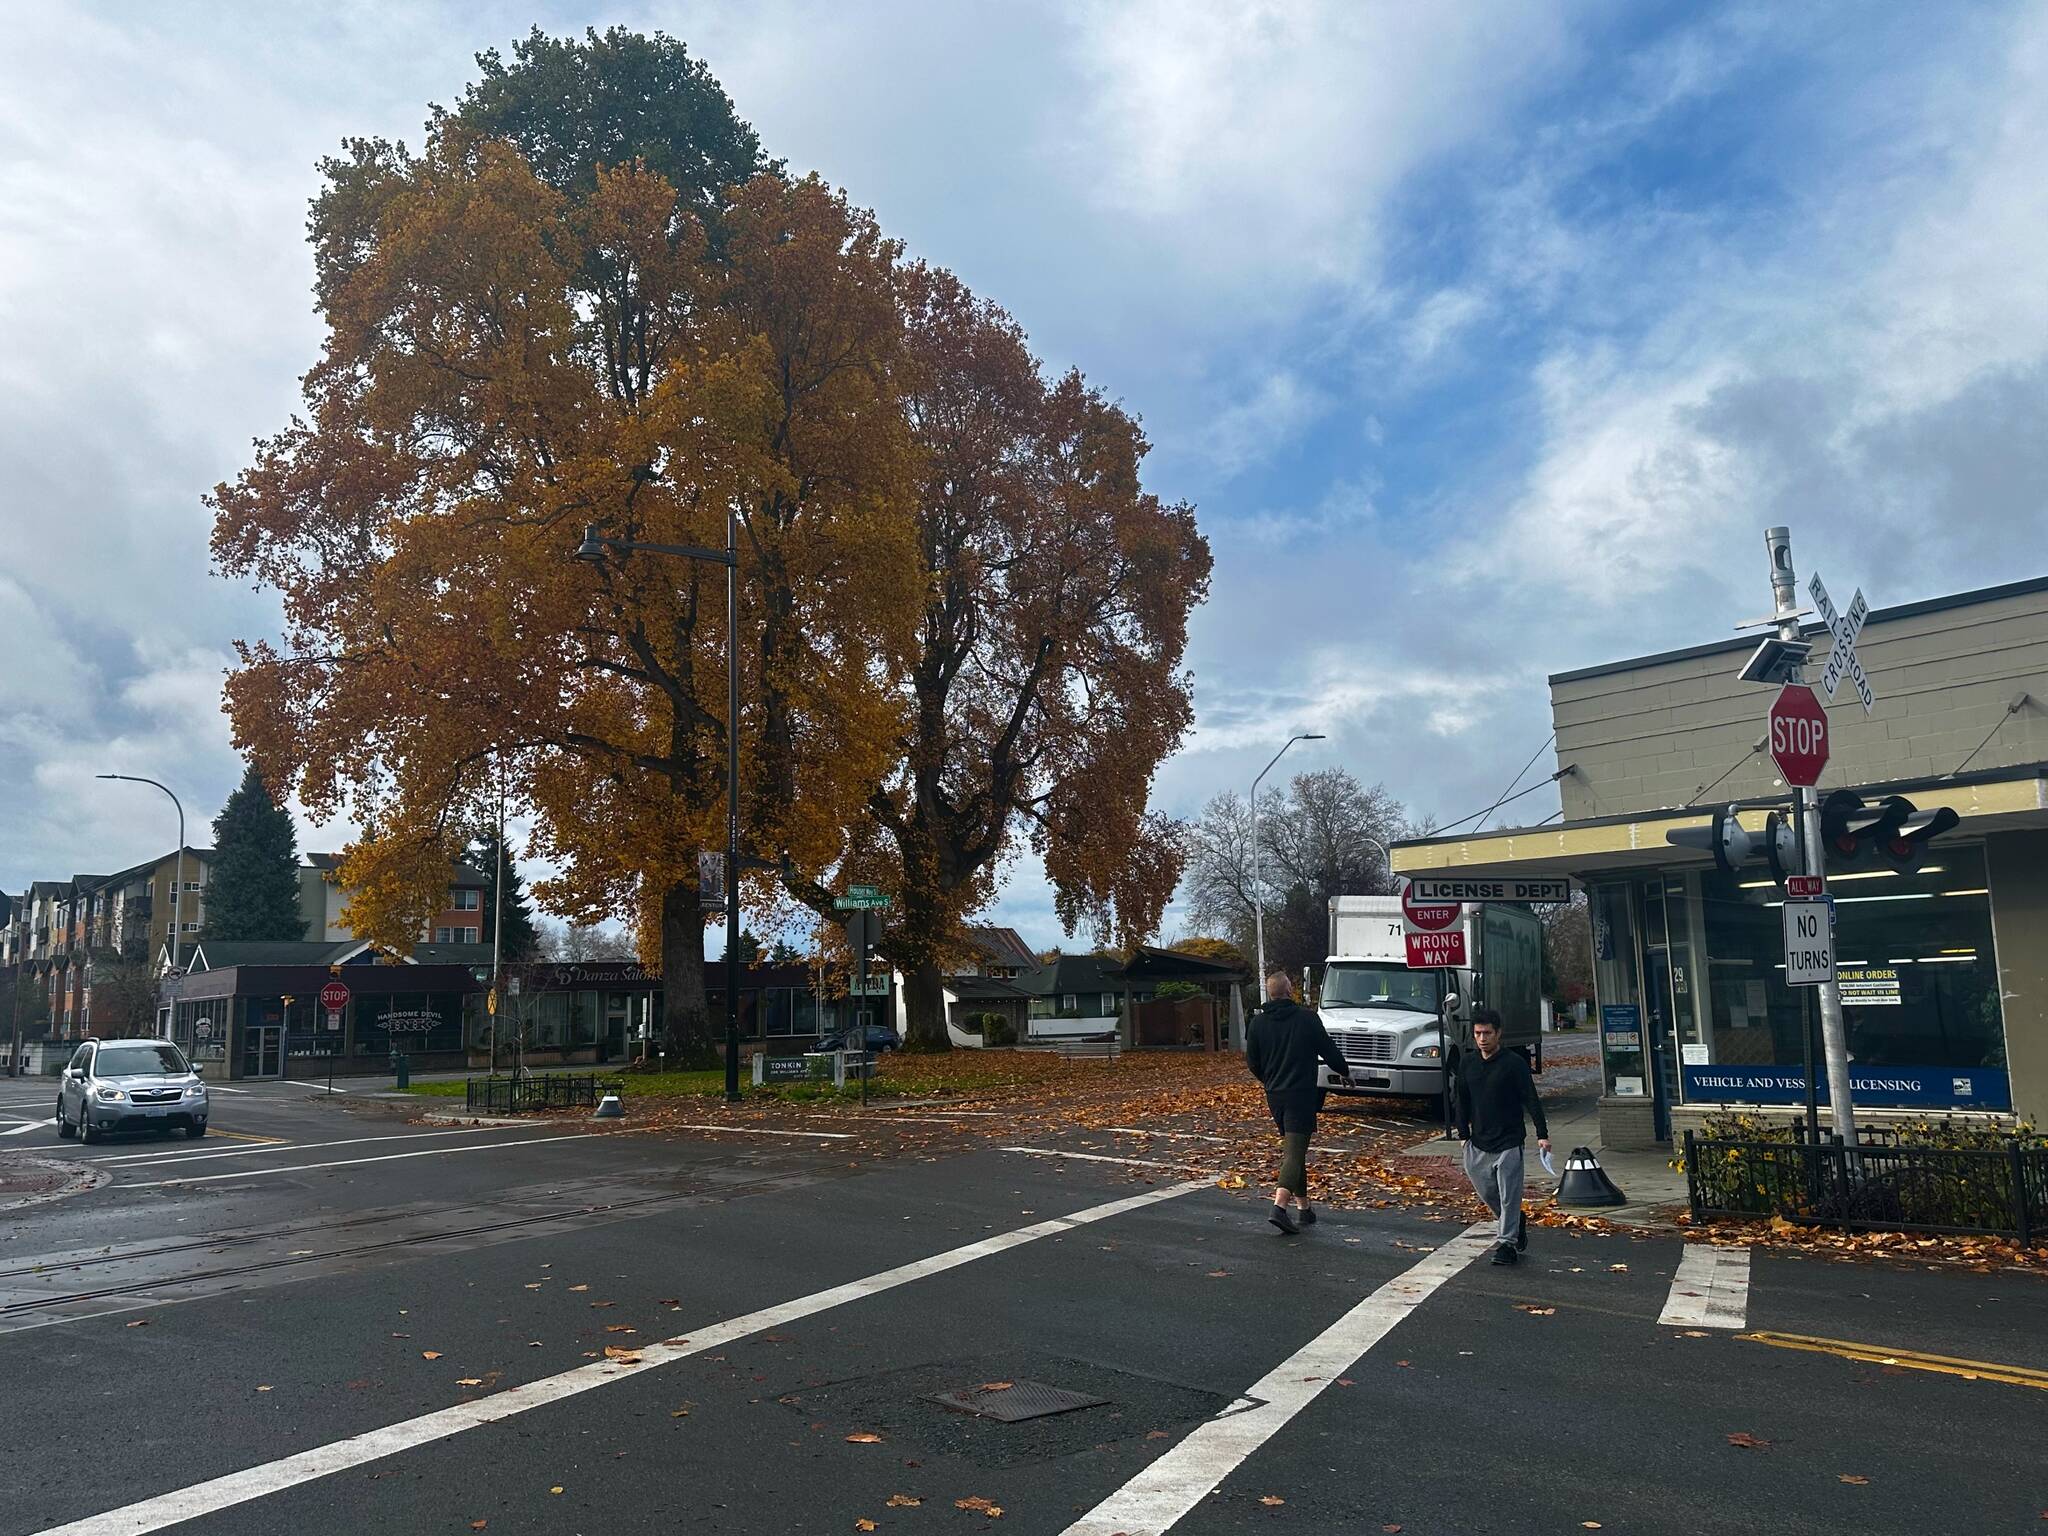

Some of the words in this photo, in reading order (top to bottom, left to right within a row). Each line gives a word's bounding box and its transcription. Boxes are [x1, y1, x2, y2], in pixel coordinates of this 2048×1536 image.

[1812, 577, 1837, 636] RAIL
[1848, 652, 1872, 706] ROAD
[1822, 595, 1866, 694] CROSSING
[1774, 716, 1824, 755] STOP
[1420, 883, 1504, 897] LICENSE
[1516, 884, 1565, 898] DEPT.
[1791, 882, 1804, 893] ALL
[1807, 881, 1820, 892] WAY
[836, 899, 870, 908] Williams
[1417, 910, 1449, 920] ENTER
[1797, 915, 1817, 938] NO
[1411, 934, 1460, 949] WRONG
[1423, 951, 1449, 965] WAY
[1789, 950, 1829, 970] TURNS
[576, 969, 618, 981] Danza
[1838, 971, 1864, 980] ONLINE
[1866, 970, 1897, 979] ORDERS
[323, 991, 348, 1001] STOP
[377, 1011, 419, 1020] HANDSOME
[421, 1011, 442, 1019] DEVIL
[388, 1018, 432, 1031] INK
[1694, 1076, 1744, 1088] VEHICLE
[1746, 1077, 1774, 1088] AND
[1849, 1080, 1921, 1092] LICENSING
